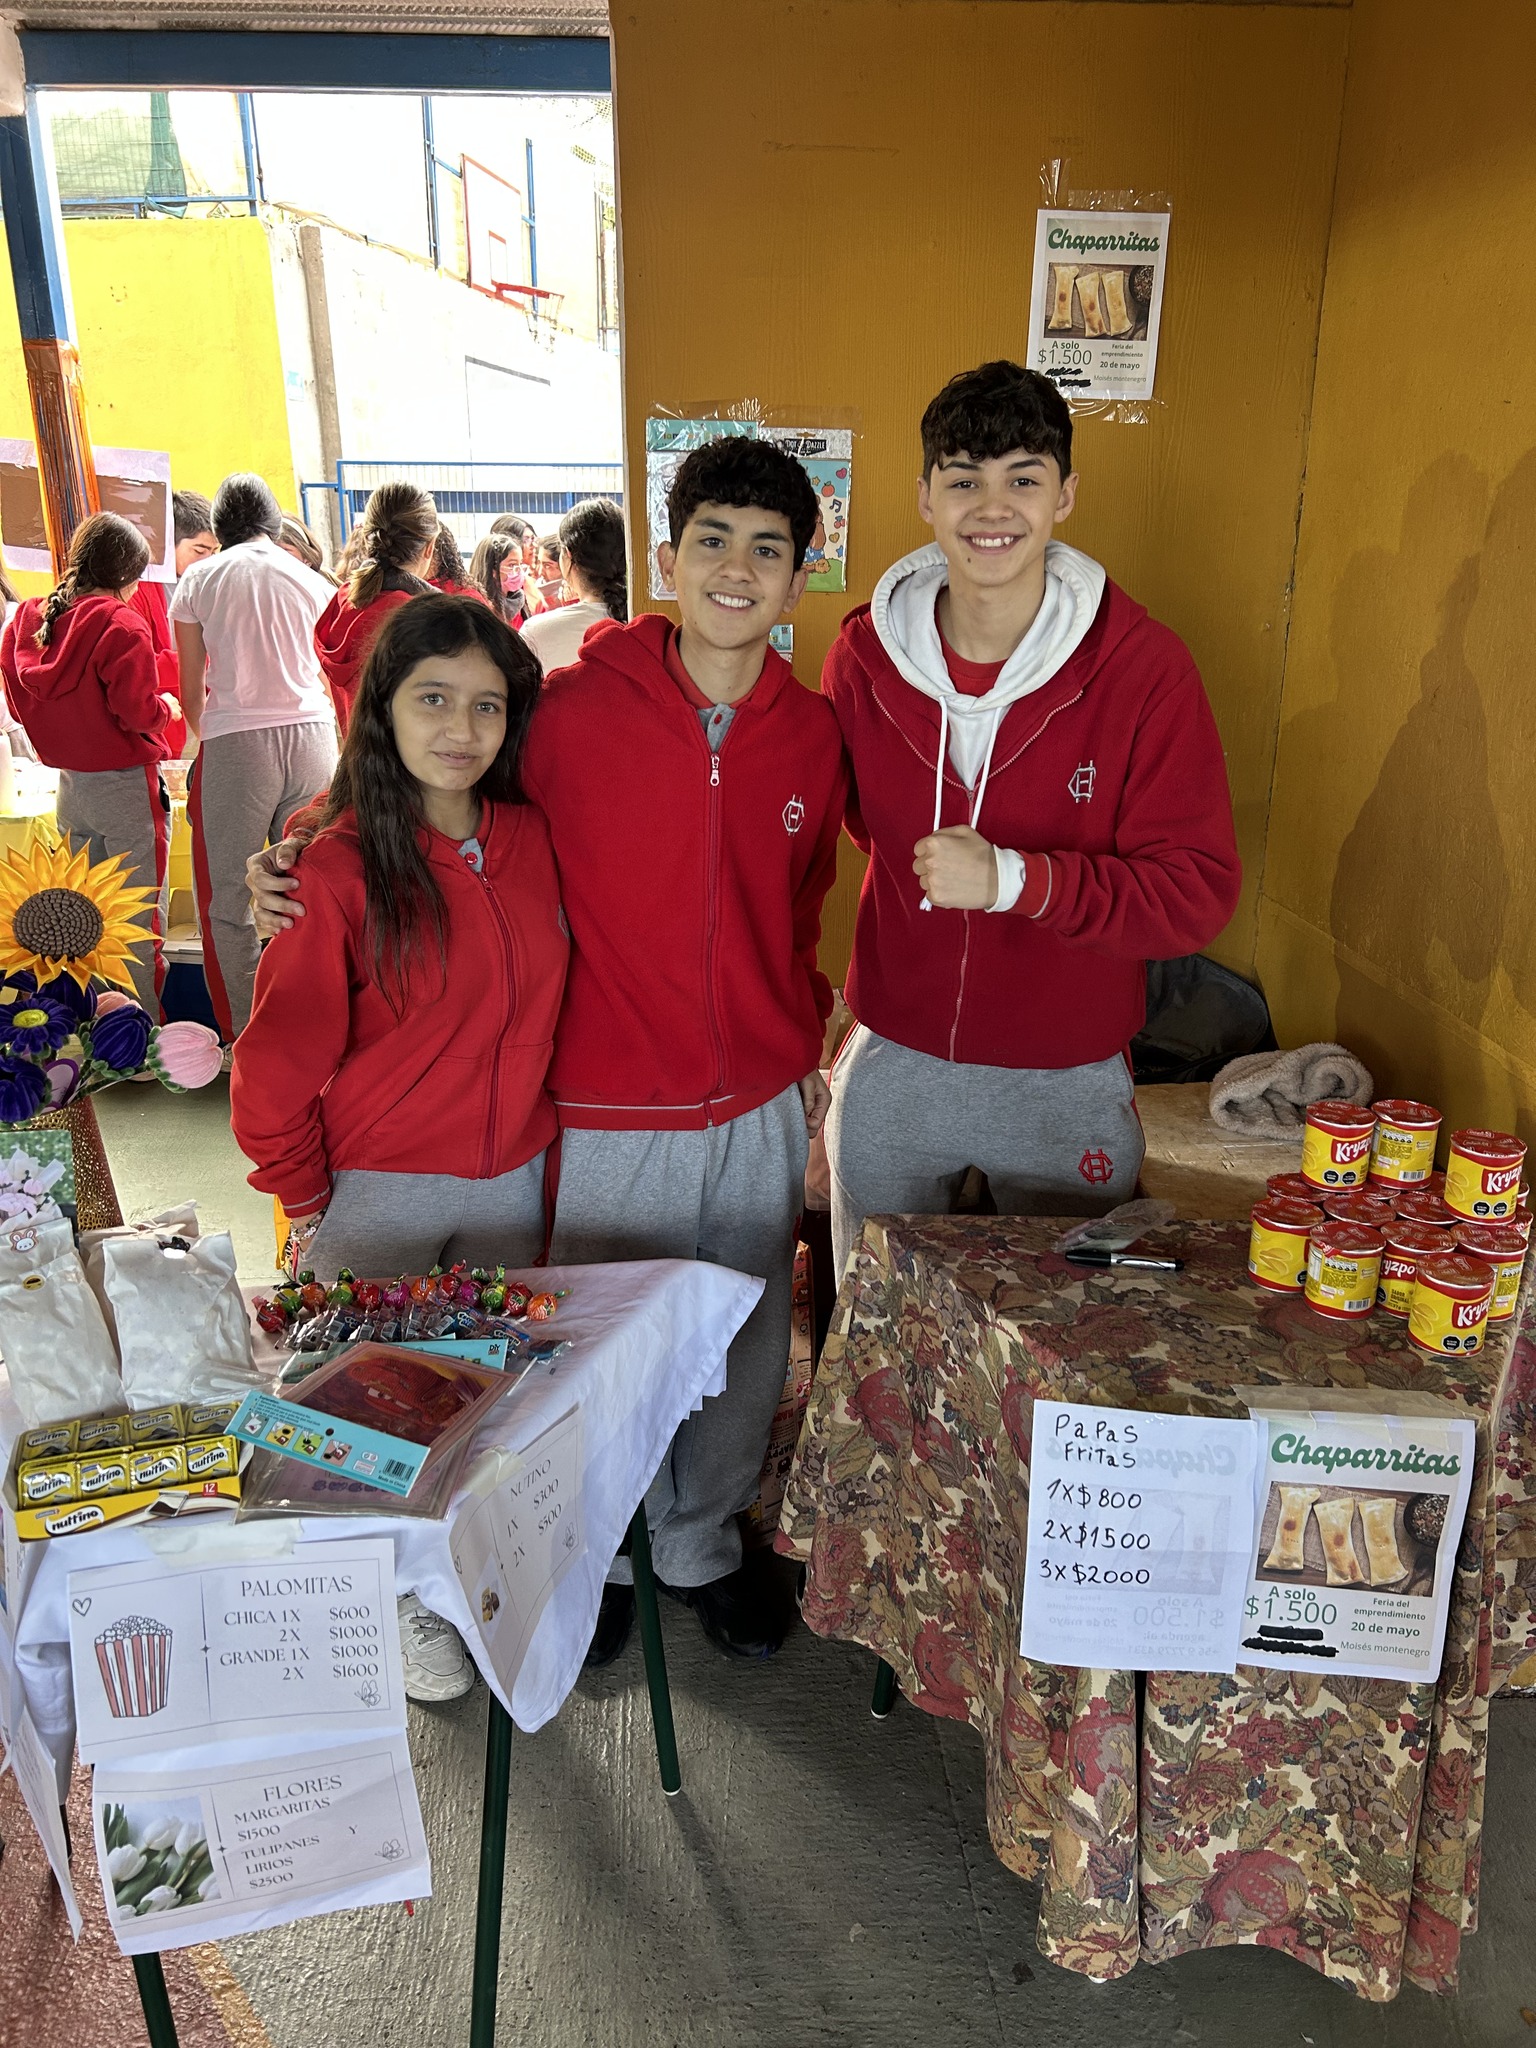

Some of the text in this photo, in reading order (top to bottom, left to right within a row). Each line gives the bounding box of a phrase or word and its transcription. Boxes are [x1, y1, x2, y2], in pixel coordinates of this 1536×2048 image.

[1048, 228, 1160, 255] Chaparritas
[1052, 341, 1080, 350] A solo
[1038, 348, 1092, 365] $1.500
[1110, 361, 1118, 369] de
[1120, 362, 1140, 370] mayo
[1335, 1135, 1370, 1163] Kryzp
[1487, 1166, 1522, 1193] Kryzp
[192, 1452, 225, 1470] nuttino
[1271, 1433, 1461, 1476] Chaparritas
[86, 1469, 121, 1488] nuttino
[510, 1458, 551, 1502] NUTINO
[205, 1483, 216, 1493] 12
[52, 1510, 98, 1531] nuttino
[241, 1575, 353, 1598] PALOMITAS
[1269, 1586, 1316, 1601] A solo
[1244, 1595, 1338, 1625] $1.500
[1373, 1598, 1409, 1608] Feria del
[224, 1610, 276, 1626] CHICA
[329, 1606, 370, 1622] $600
[1354, 1607, 1426, 1621] emprendimiento
[329, 1625, 378, 1641] $1000
[1351, 1622, 1420, 1637] 20 de mayo
[220, 1648, 286, 1666] GRANDE
[331, 1644, 379, 1660] $1000
[1340, 1641, 1431, 1658] Moisés montenegro
[332, 1663, 379, 1679] $1600
[263, 1775, 342, 1802] FLORES
[234, 1797, 330, 1824] MARGARITAS
[237, 1825, 281, 1842] $1500
[241, 1825, 357, 1860] TULIPANES Y
[246, 1857, 294, 1875] LIRIOS
[249, 1872, 294, 1889] $2500
